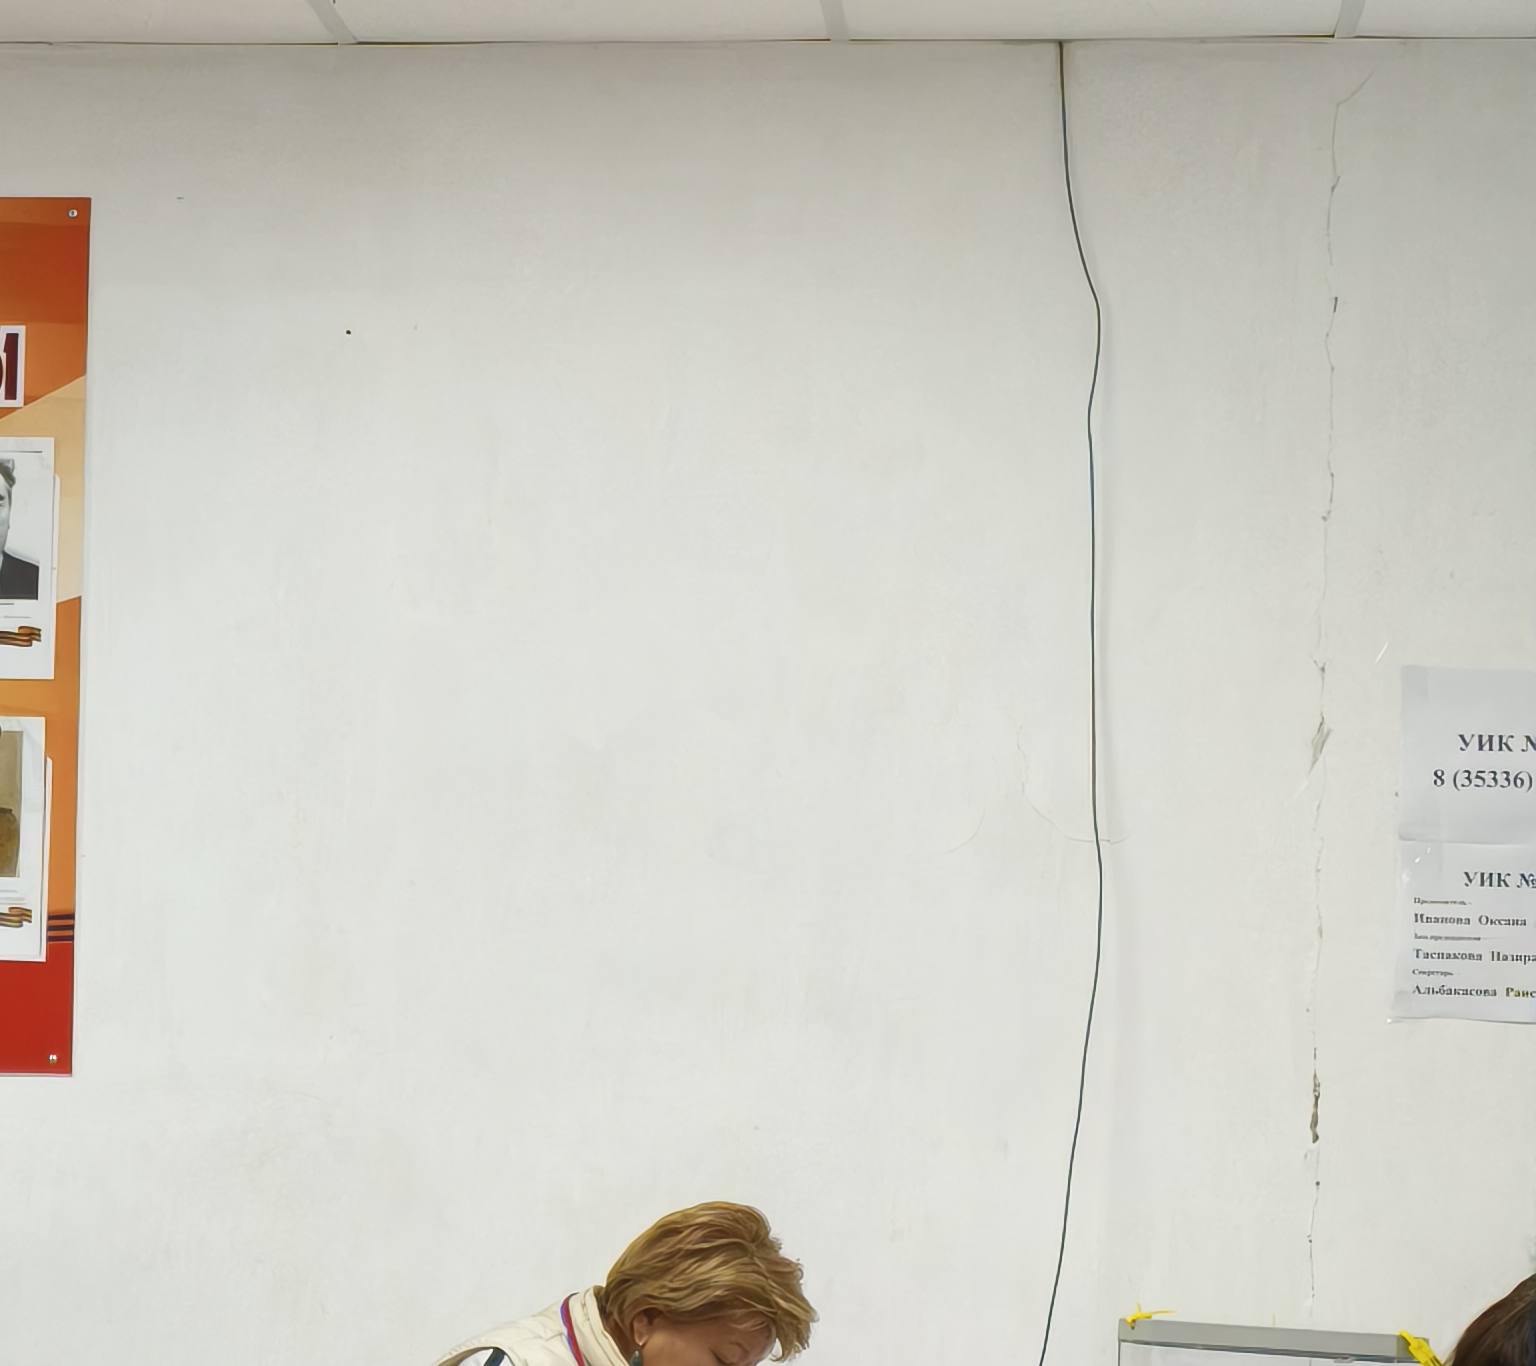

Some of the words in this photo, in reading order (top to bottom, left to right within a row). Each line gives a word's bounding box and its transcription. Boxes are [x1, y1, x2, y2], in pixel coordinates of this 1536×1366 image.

[1458, 733, 1514, 752] УИК
[1433, 768, 1445, 788] 8
[1453, 769, 1533, 793] (35336)
[1463, 871, 1511, 888] УИК
